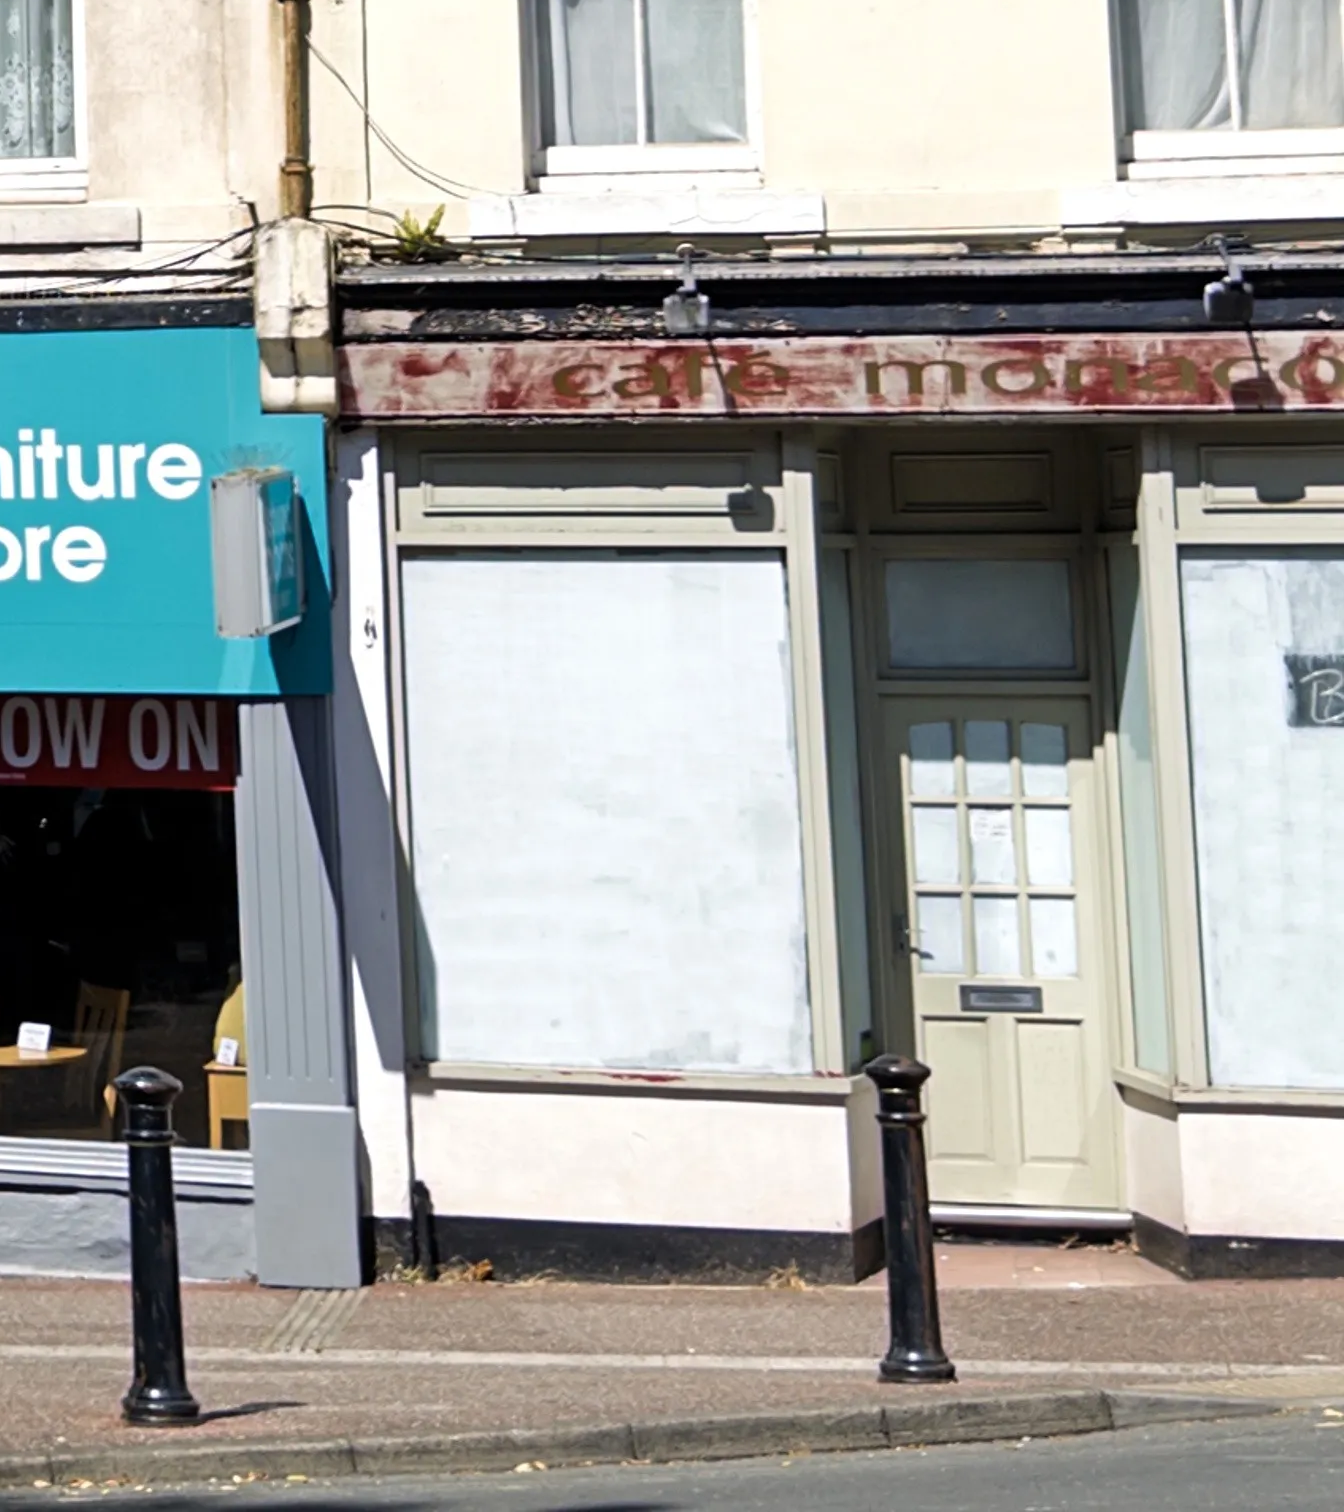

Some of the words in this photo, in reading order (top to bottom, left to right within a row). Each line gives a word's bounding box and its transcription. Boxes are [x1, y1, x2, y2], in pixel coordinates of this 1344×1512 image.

[551, 349, 789, 399] café
[865, 354, 1344, 396] monaco
[128, 699, 220, 771] ON
